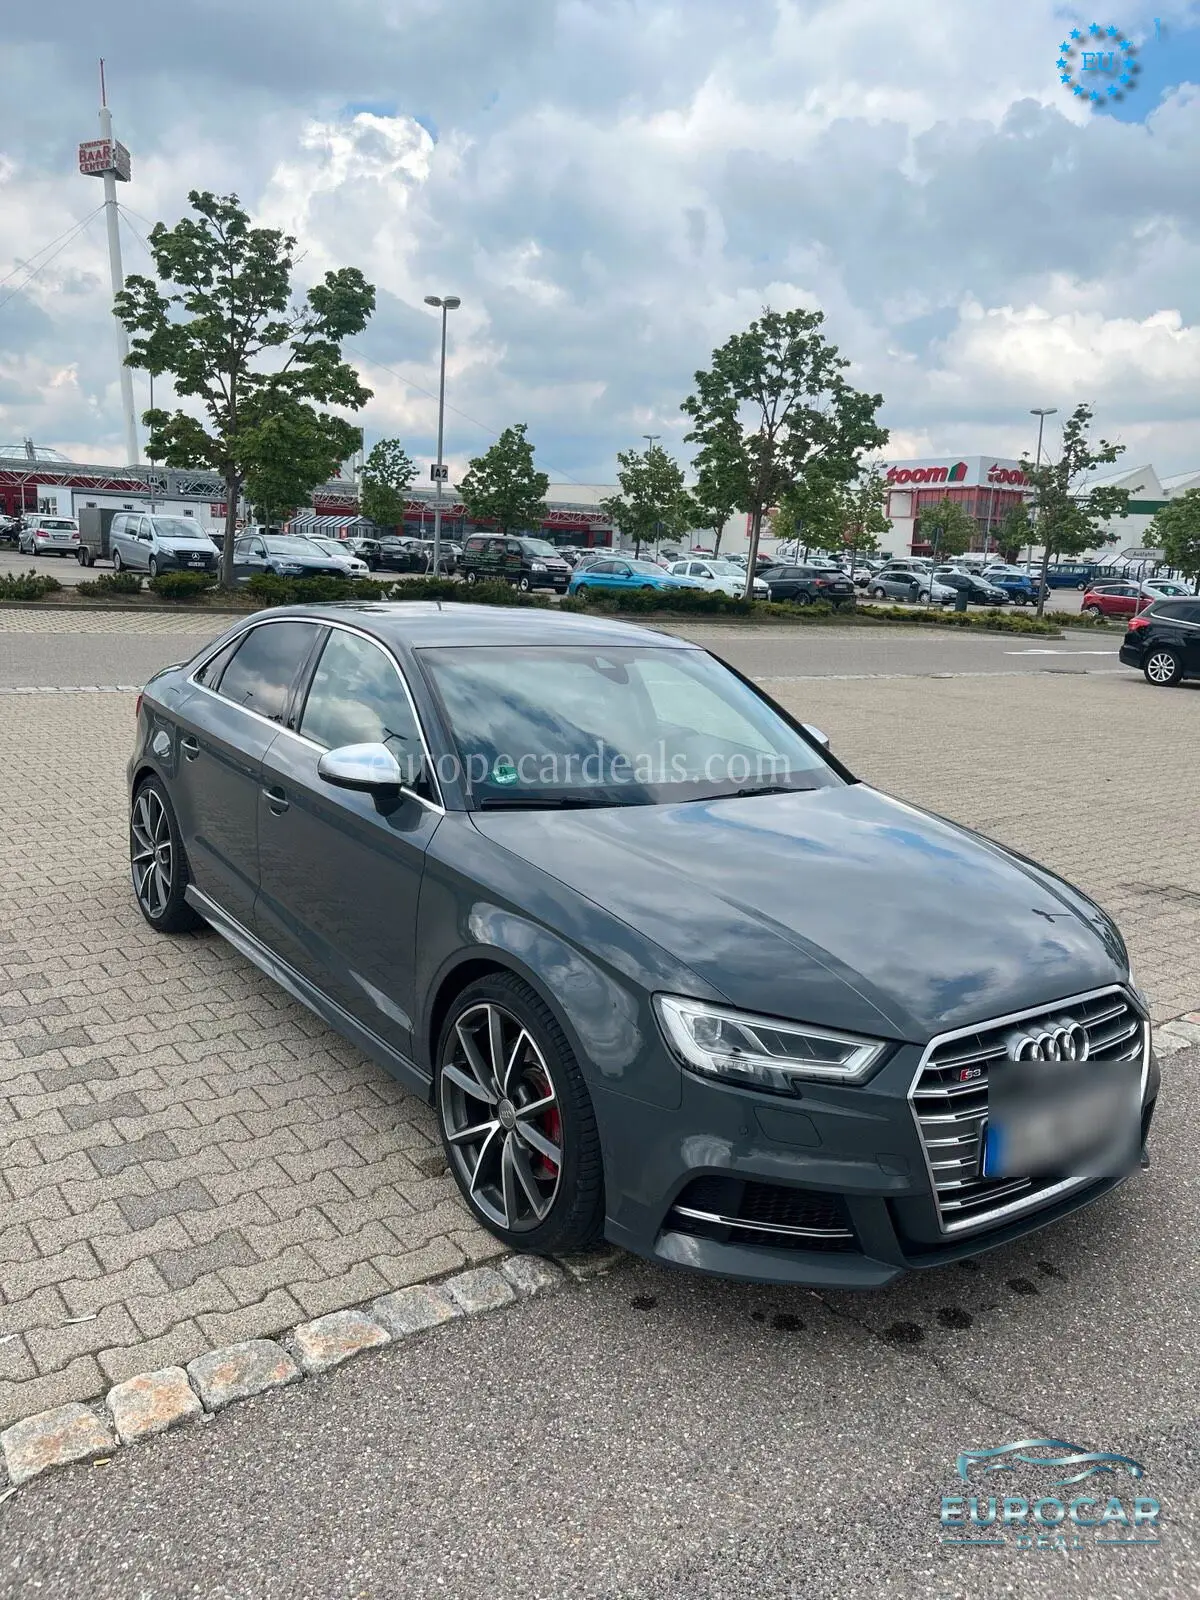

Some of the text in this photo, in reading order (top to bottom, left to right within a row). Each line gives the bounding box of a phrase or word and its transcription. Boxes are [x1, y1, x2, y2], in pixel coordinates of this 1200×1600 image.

[79, 145, 112, 163] BAAR
[80, 160, 111, 172] CENTER
[435, 468, 448, 479] A2
[886, 465, 949, 484] toom
[960, 1068, 981, 1081] S3
